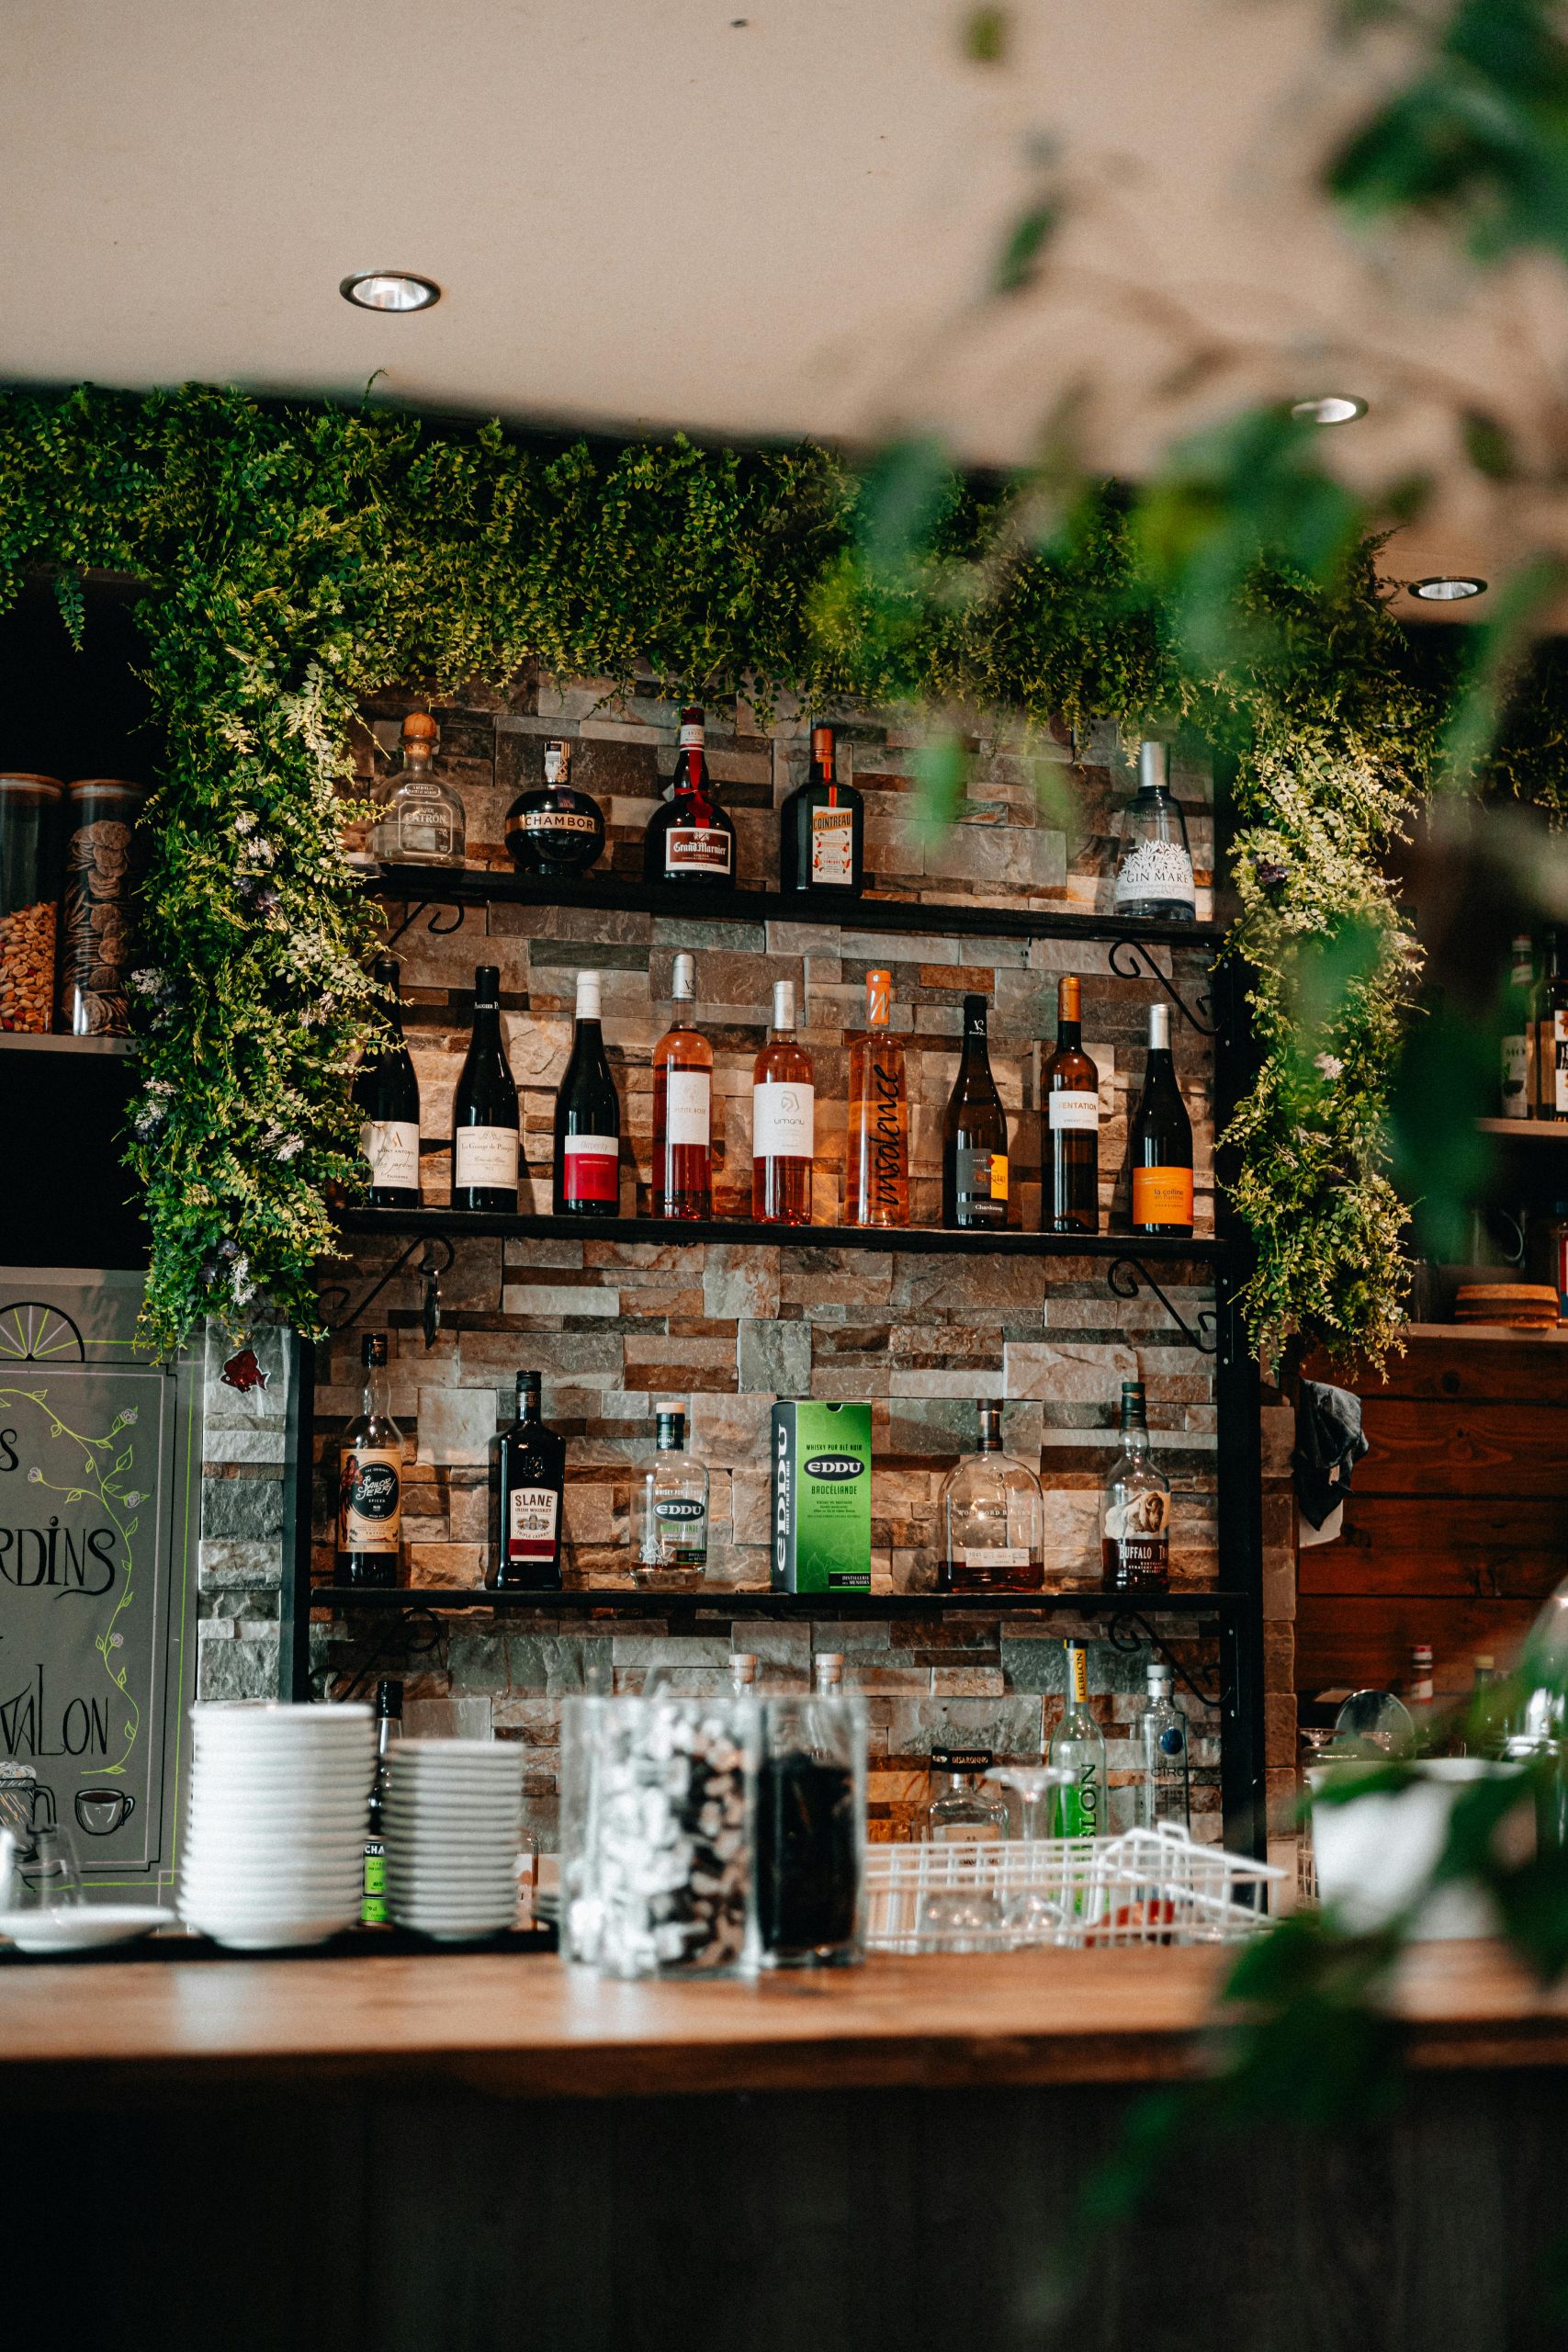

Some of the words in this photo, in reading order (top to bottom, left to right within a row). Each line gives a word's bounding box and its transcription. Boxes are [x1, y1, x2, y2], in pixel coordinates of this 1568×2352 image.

[813, 814, 851, 830] COINTREAU
[673, 842, 697, 853] Grand
[697, 842, 727, 854] Marnier
[1126, 872, 1149, 883] GIN
[1154, 872, 1189, 884] MARE
[1058, 1102, 1097, 1111] TENTATION
[867, 1063, 901, 1205] insolence
[807, 1462, 862, 1474] EDDU
[811, 1484, 858, 1495] BROCÉLIANDE
[514, 1494, 553, 1508] SLANE
[777, 1423, 787, 1572] EDDU
[656, 1505, 702, 1515] EDDU
[1119, 1544, 1152, 1560] BUFFALO
[1077, 1653, 1086, 1697] LEBLON
[952, 1756, 988, 1765] DISARONNO
[364, 1845, 385, 1855] CHA
